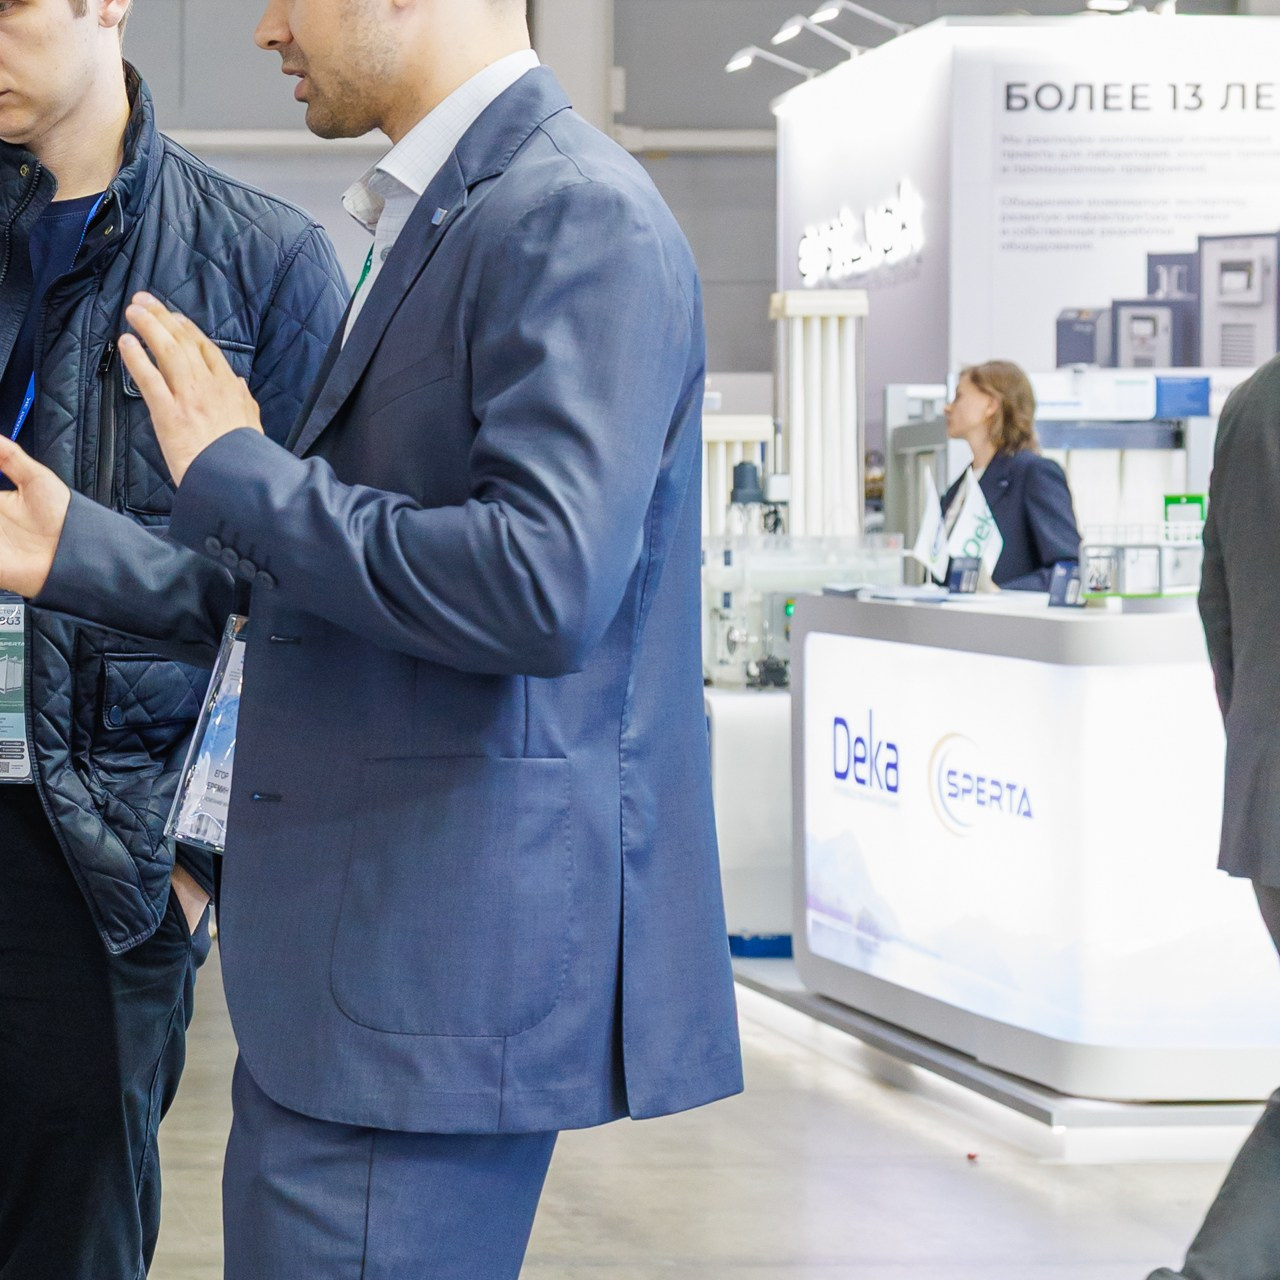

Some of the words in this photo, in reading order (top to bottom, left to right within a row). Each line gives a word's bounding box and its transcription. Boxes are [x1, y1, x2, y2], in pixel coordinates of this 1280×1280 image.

[1004, 82, 1151, 112] БОЛЕЕ
[1168, 82, 1204, 112] 13
[833, 708, 899, 794] Deka
[946, 770, 1034, 819] SPERTA
